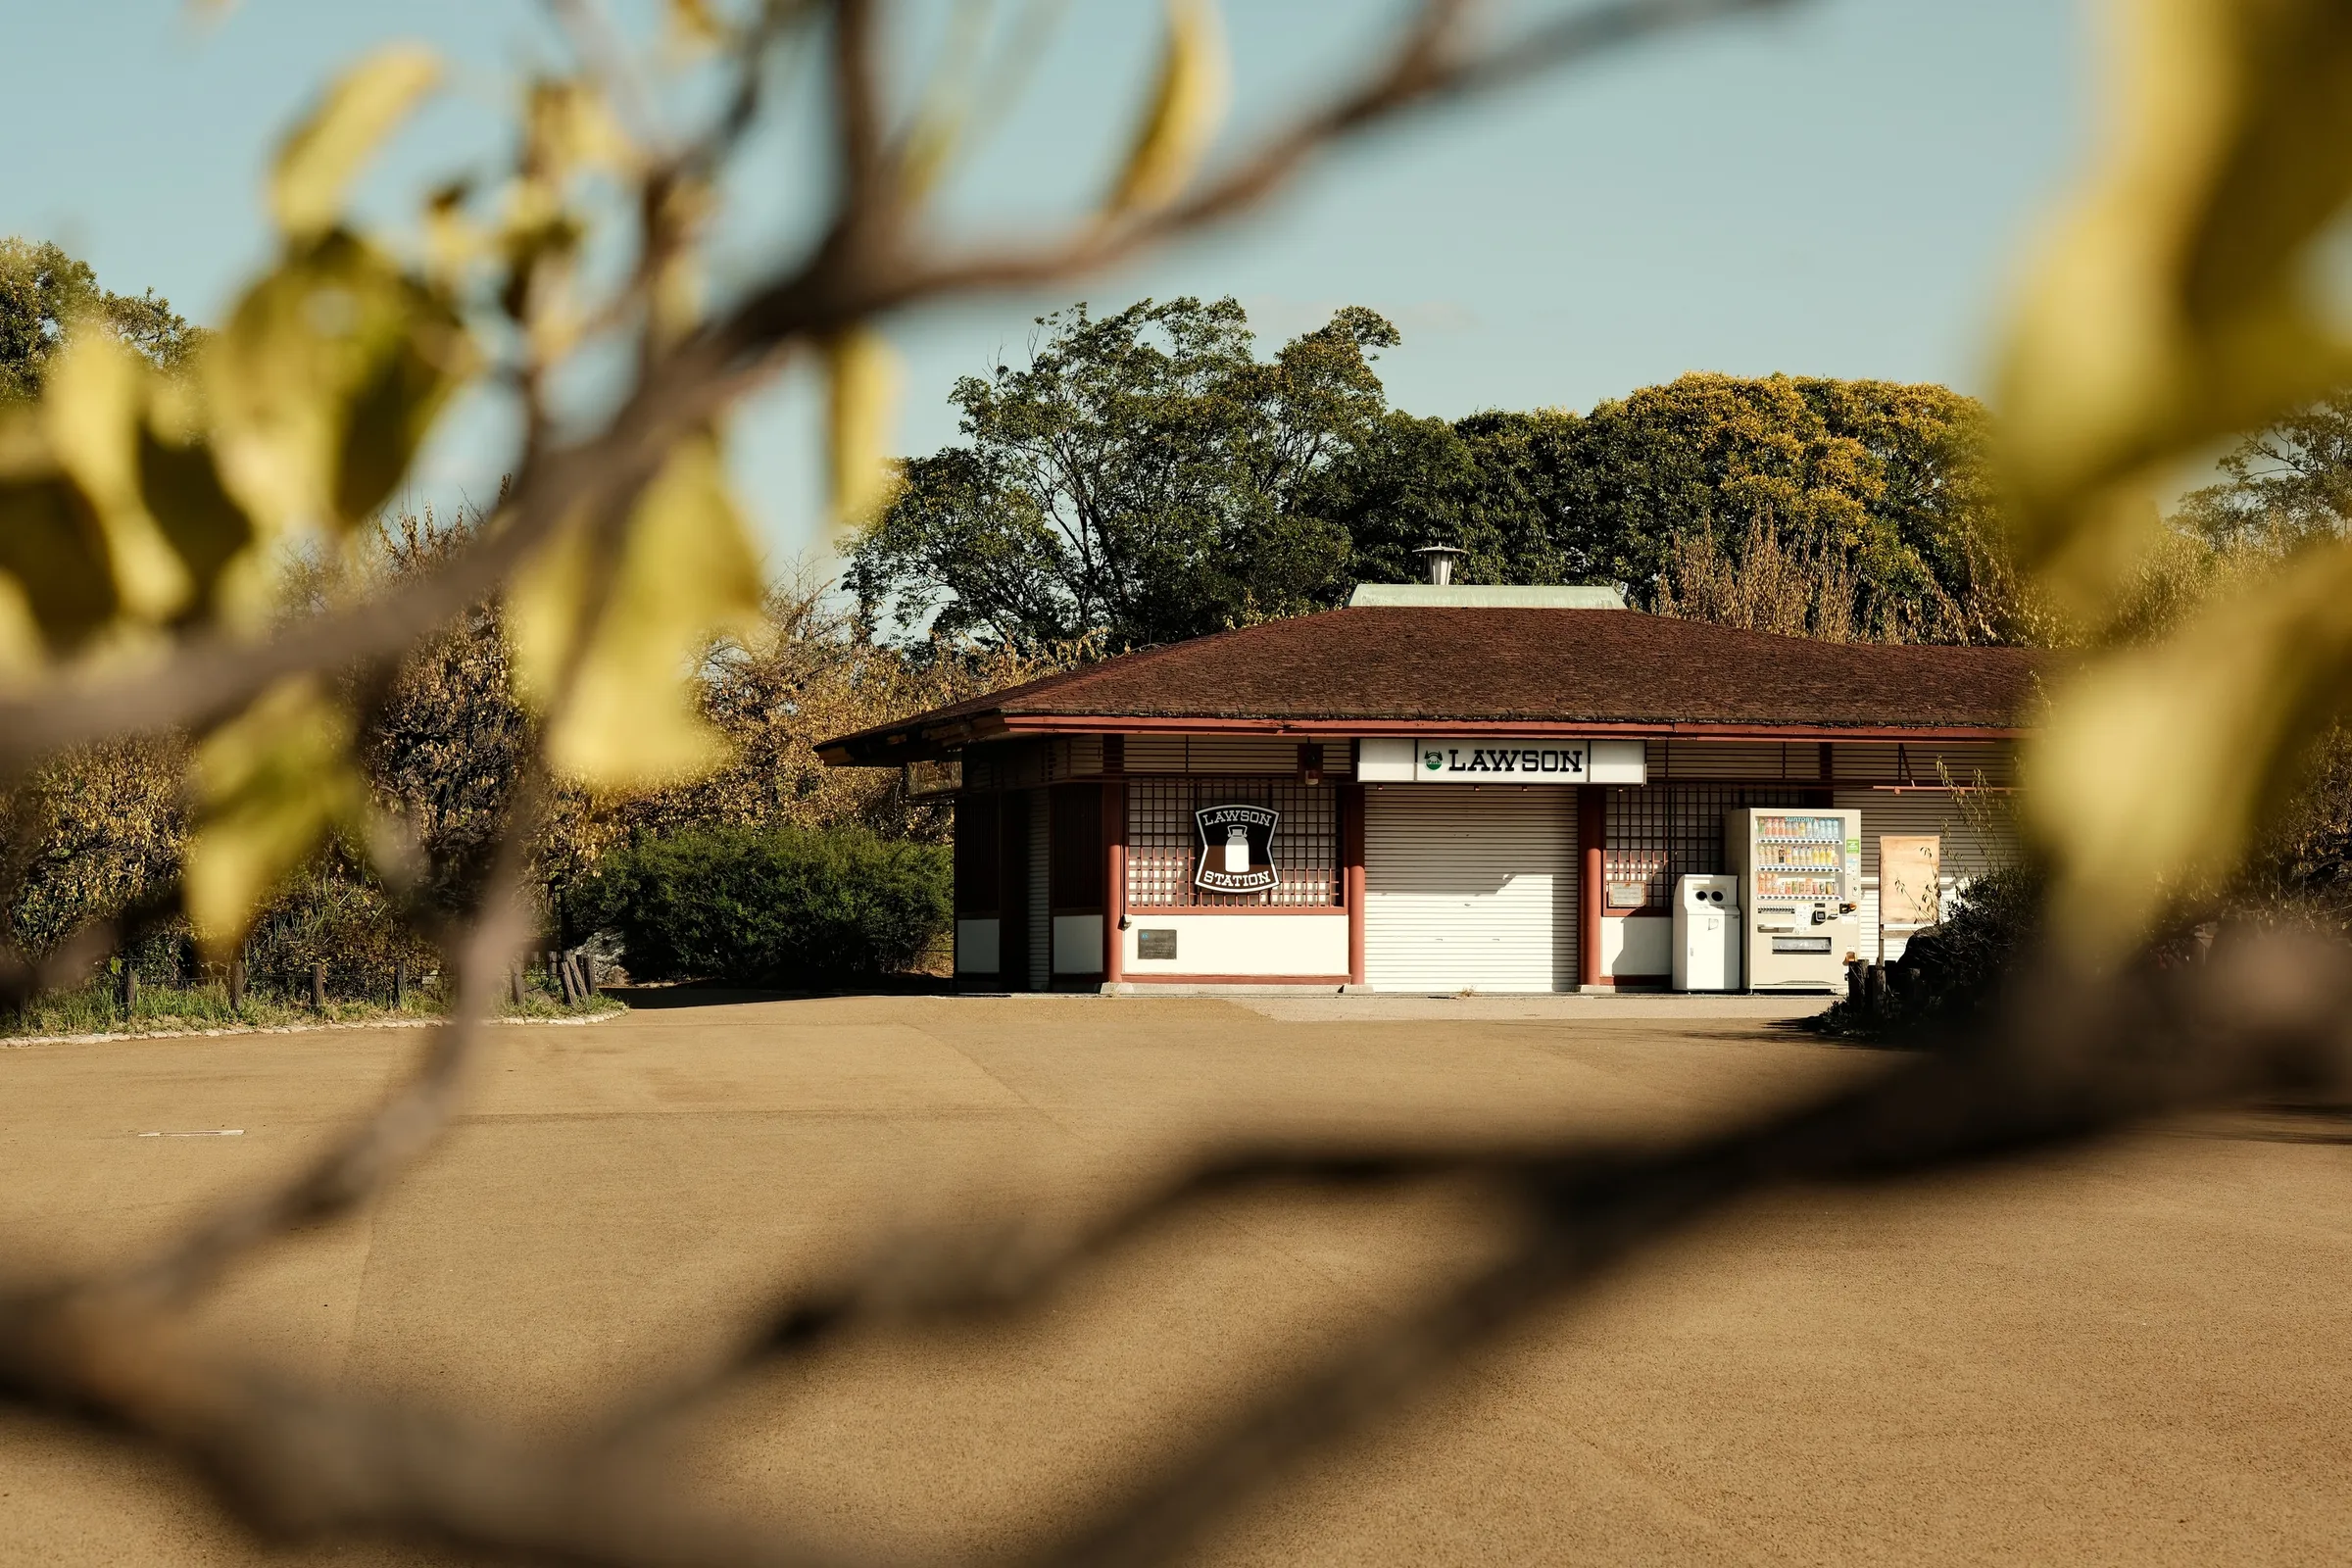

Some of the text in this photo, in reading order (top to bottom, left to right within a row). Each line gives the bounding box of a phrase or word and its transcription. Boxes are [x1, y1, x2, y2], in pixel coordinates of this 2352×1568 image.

[1448, 750, 1583, 772] LAWSON
[1202, 809, 1272, 826] LAWSON
[1203, 870, 1271, 886] STATION
